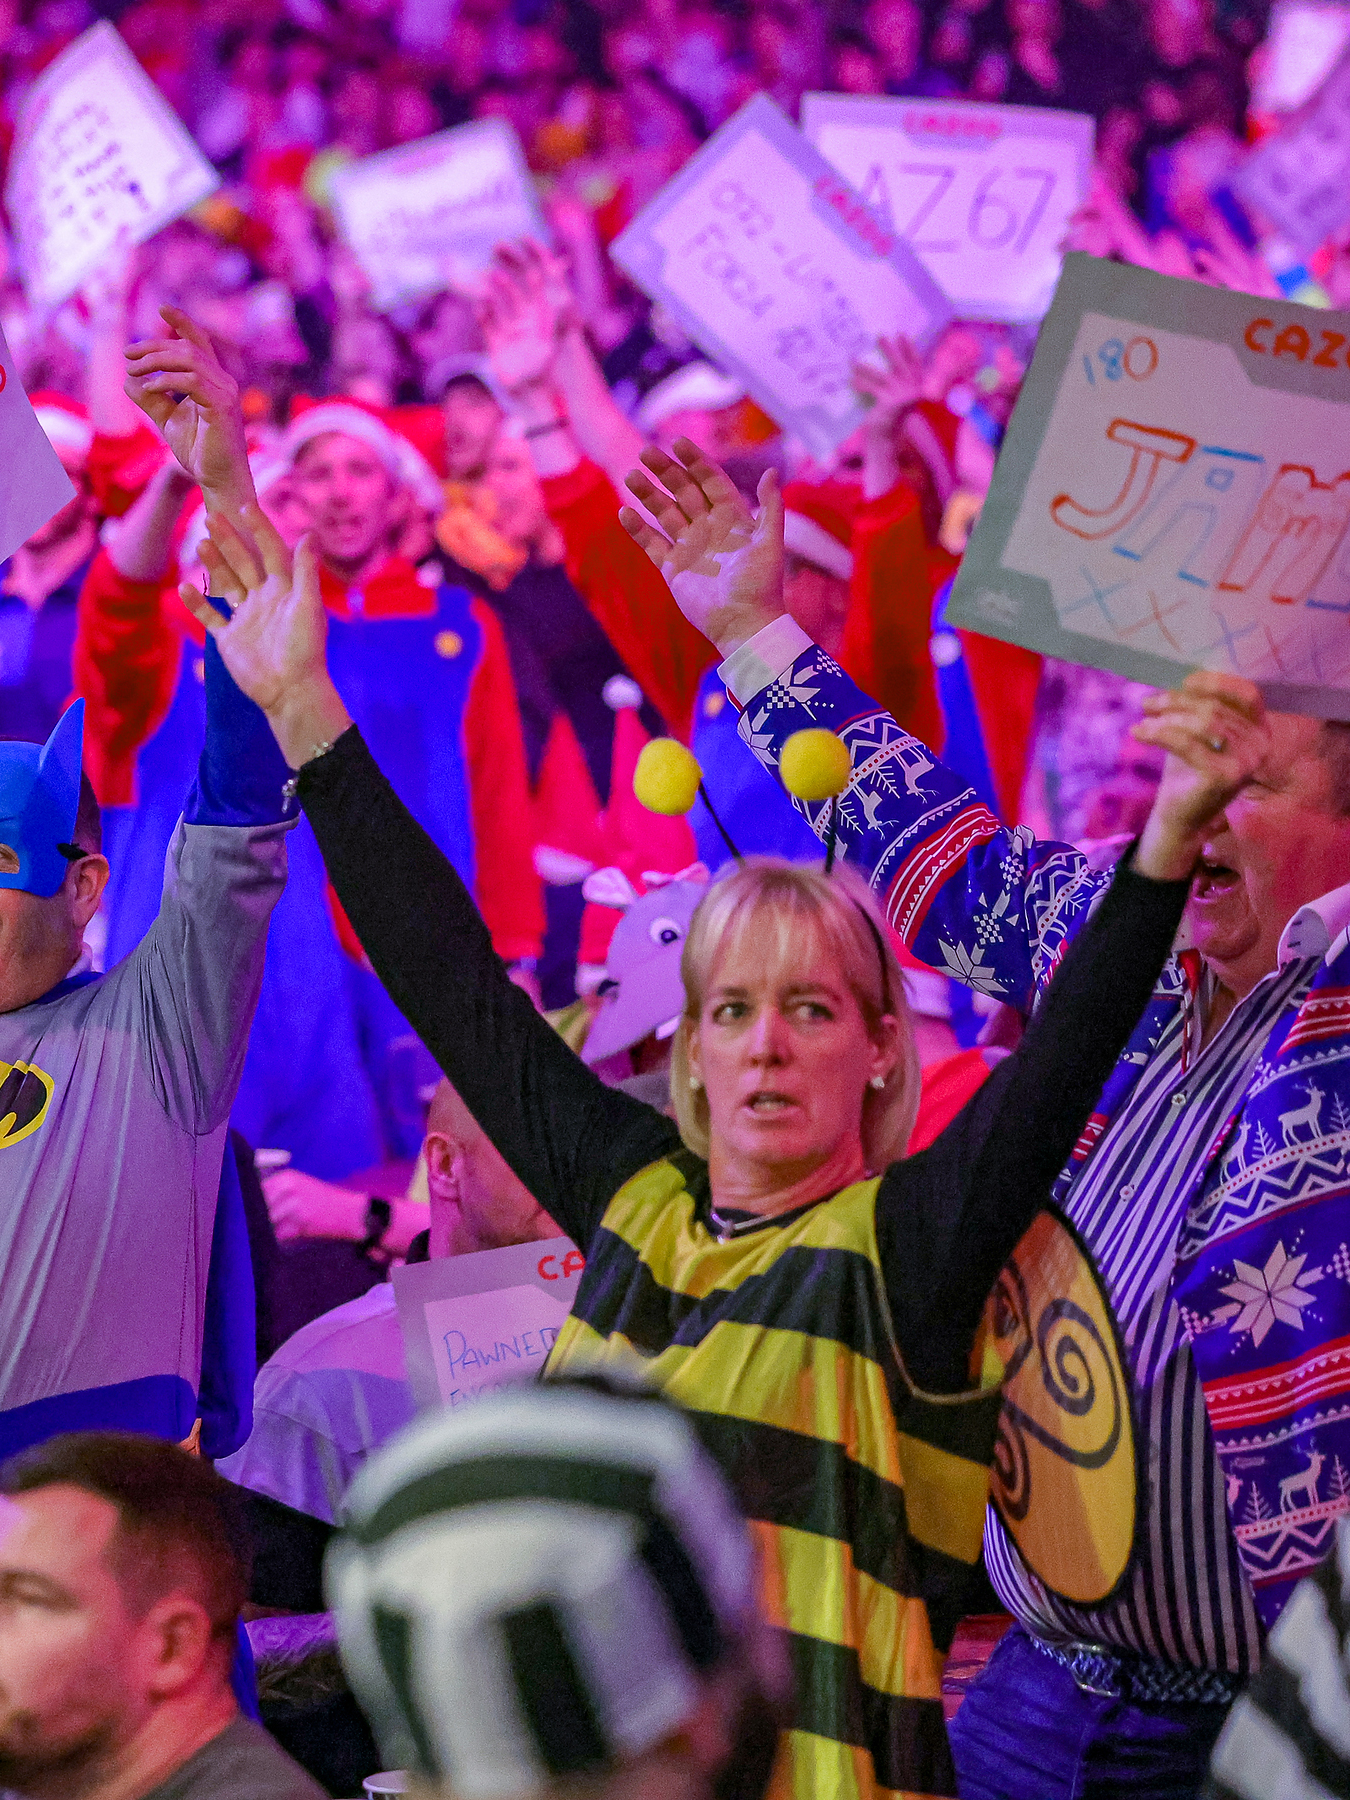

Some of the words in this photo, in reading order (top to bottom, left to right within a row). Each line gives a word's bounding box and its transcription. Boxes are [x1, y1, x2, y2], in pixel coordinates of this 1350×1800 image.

[1082, 335, 1160, 386] 180
[1244, 318, 1350, 369] CAZ
[1049, 417, 1350, 612] JAM
